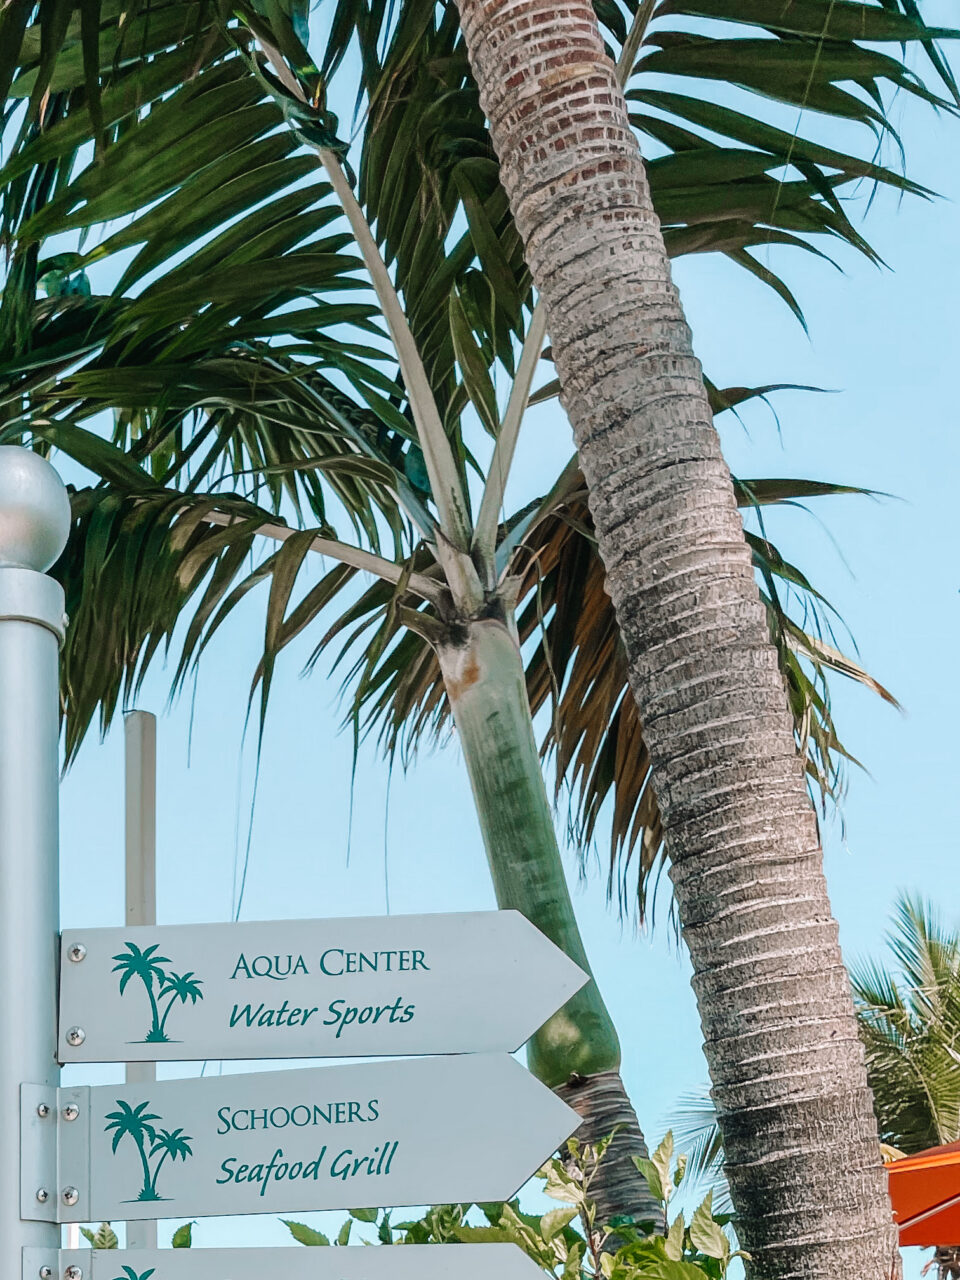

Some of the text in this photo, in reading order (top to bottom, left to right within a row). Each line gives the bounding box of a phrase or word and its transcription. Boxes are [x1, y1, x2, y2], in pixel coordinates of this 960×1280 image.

[229, 948, 431, 981] AQUA CENTER
[229, 996, 416, 1039] Water Sports
[216, 1099, 379, 1135] SCHOONERS
[215, 1140, 399, 1197] Seafood Grill
